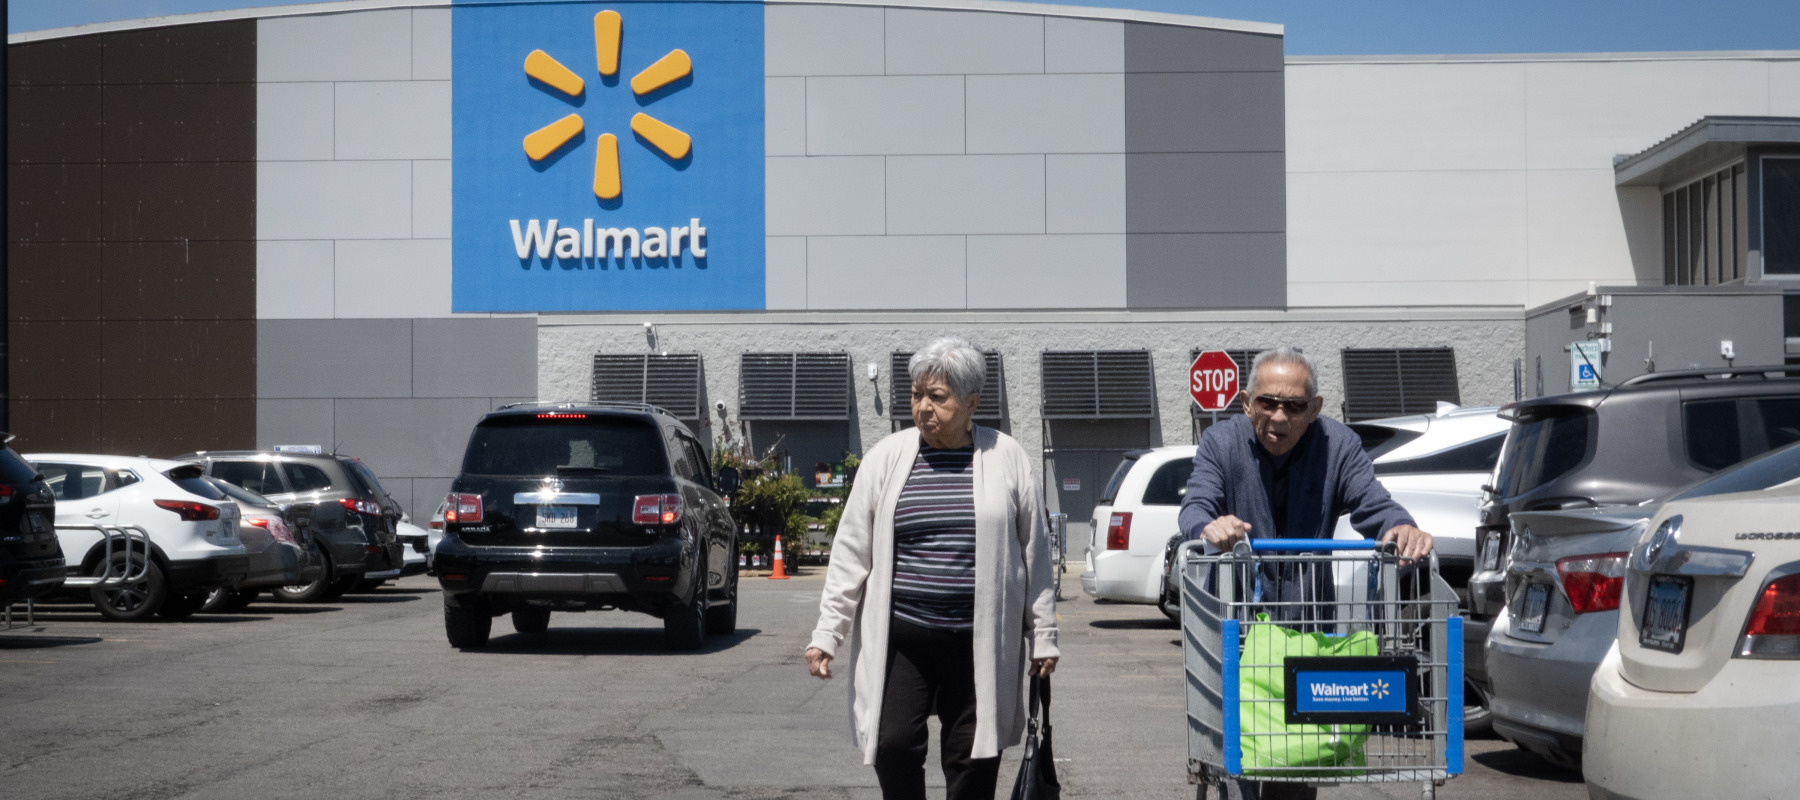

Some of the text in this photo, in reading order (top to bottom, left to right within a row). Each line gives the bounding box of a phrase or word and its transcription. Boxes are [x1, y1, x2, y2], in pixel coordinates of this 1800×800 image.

[509, 218, 707, 259] Walmart
[1192, 368, 1236, 392] STOP
[1310, 682, 1369, 696] Walmart
